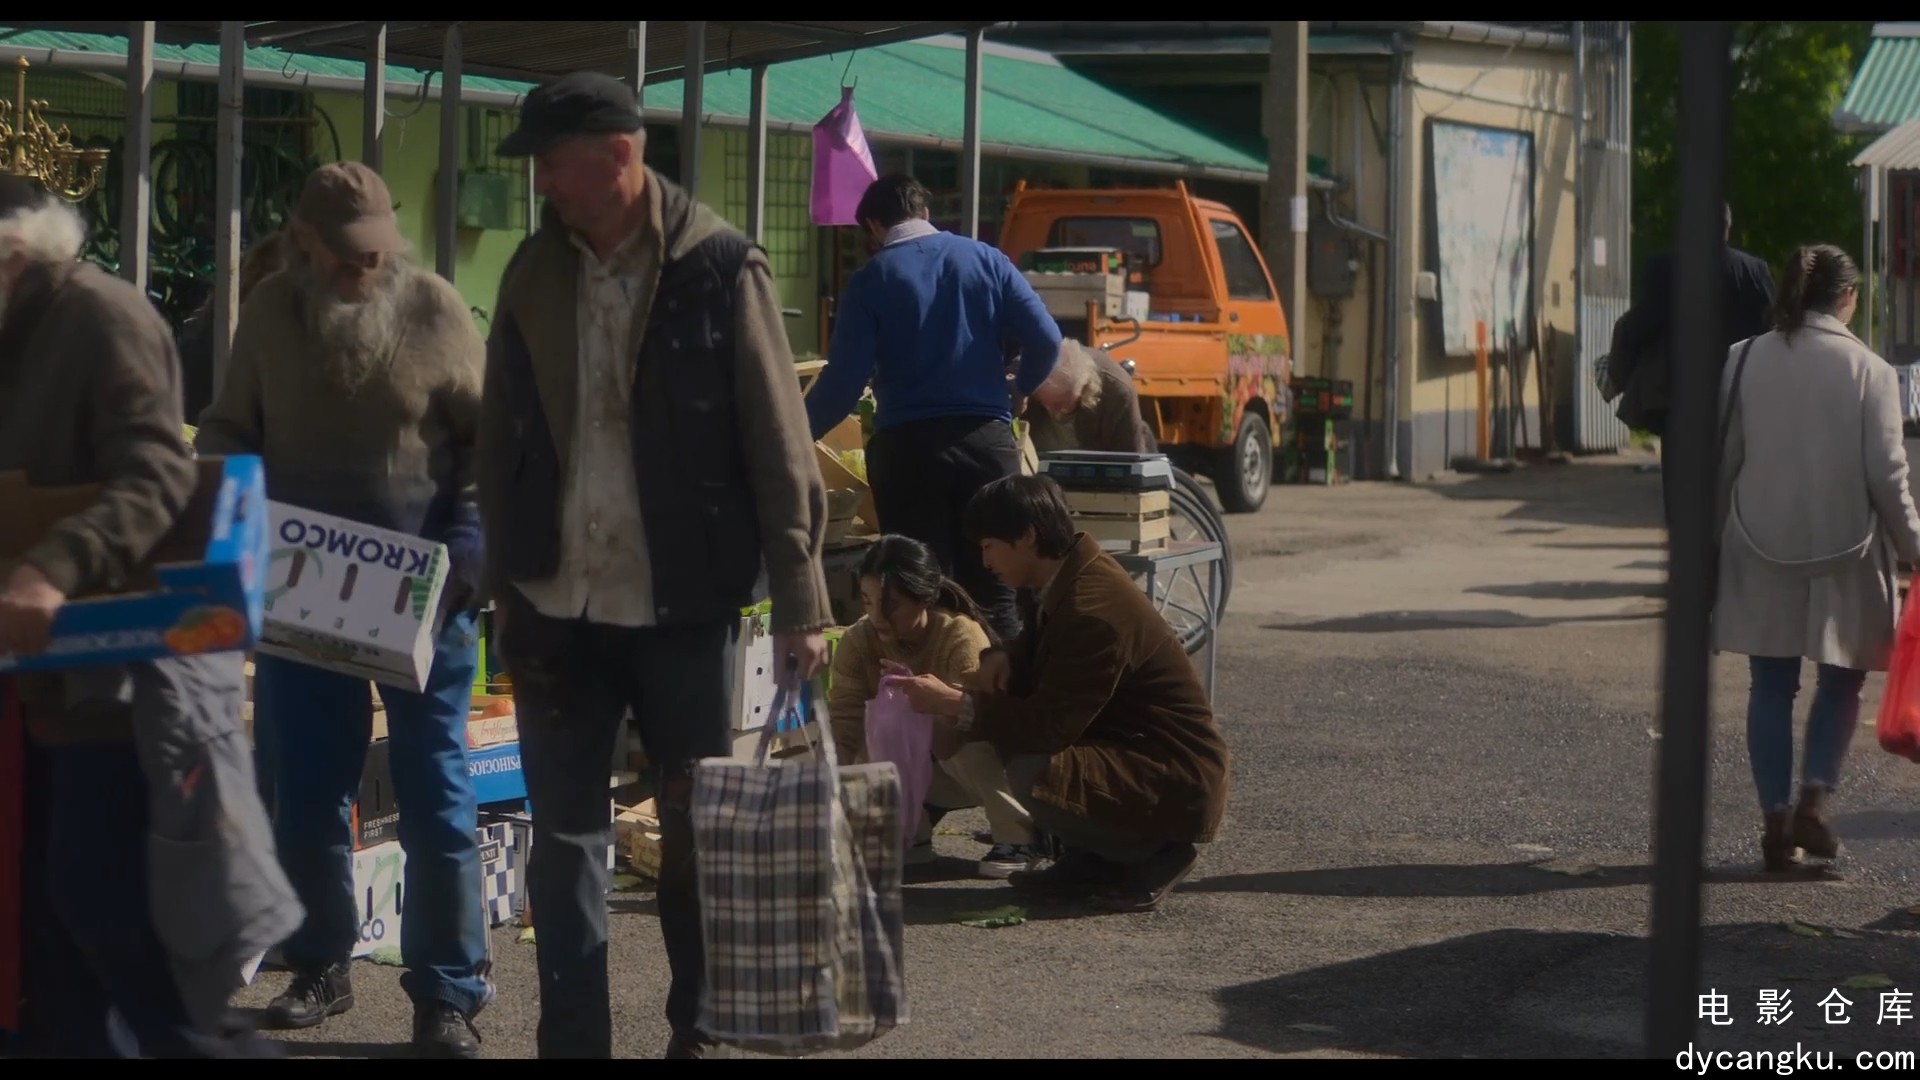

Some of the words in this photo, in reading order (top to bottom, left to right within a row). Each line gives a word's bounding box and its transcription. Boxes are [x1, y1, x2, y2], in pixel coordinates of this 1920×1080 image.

[280, 519, 429, 576] KROMCO
[469, 755, 522, 777] PSIHOGIOS
[364, 812, 400, 830] FRESHNESS
[364, 826, 383, 840] FIRST
